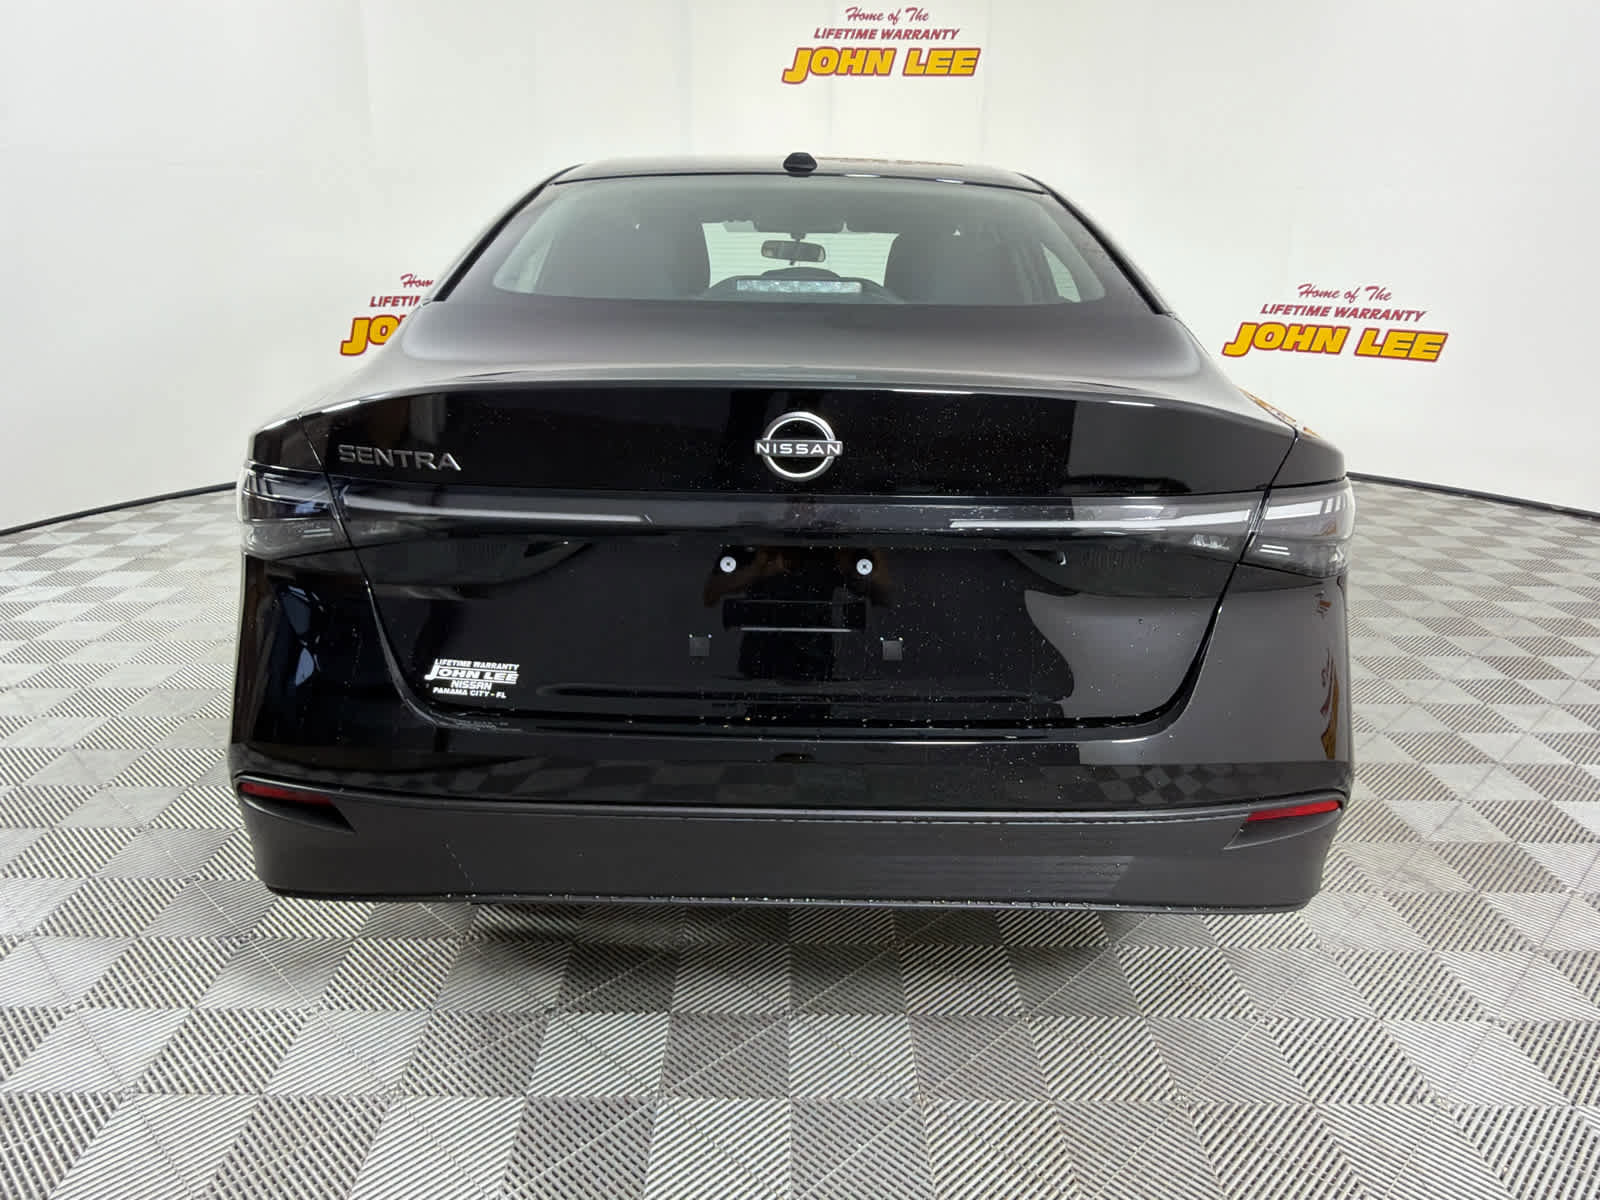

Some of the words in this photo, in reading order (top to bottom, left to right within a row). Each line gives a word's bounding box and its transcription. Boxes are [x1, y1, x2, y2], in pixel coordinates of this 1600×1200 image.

[846, 6, 884, 22] Home
[887, 9, 900, 25] of
[904, 7, 929, 21] The
[814, 28, 877, 40] LIFETIME
[881, 28, 960, 40] WARRANTY
[782, 46, 896, 84] JOHN
[902, 47, 981, 77] LEE
[1297, 283, 1340, 299] Home
[1344, 287, 1360, 303] of
[1365, 286, 1392, 301] The
[1260, 303, 1331, 318] LIFETIME
[1334, 306, 1426, 322] WARRANTY
[340, 314, 407, 356] JO
[1222, 321, 1350, 357] JOHN
[1354, 327, 1449, 363] LEE
[338, 444, 461, 471] SENTRA
[756, 442, 841, 455] NISSAN
[424, 664, 480, 680] JOHN
[483, 671, 519, 682] LEE
[435, 658, 472, 668] LIFETIME
[473, 661, 520, 671] WARRANTY
[432, 687, 468, 696] PANAMA
[495, 691, 507, 699] FL
[450, 680, 493, 690] NISSAN
